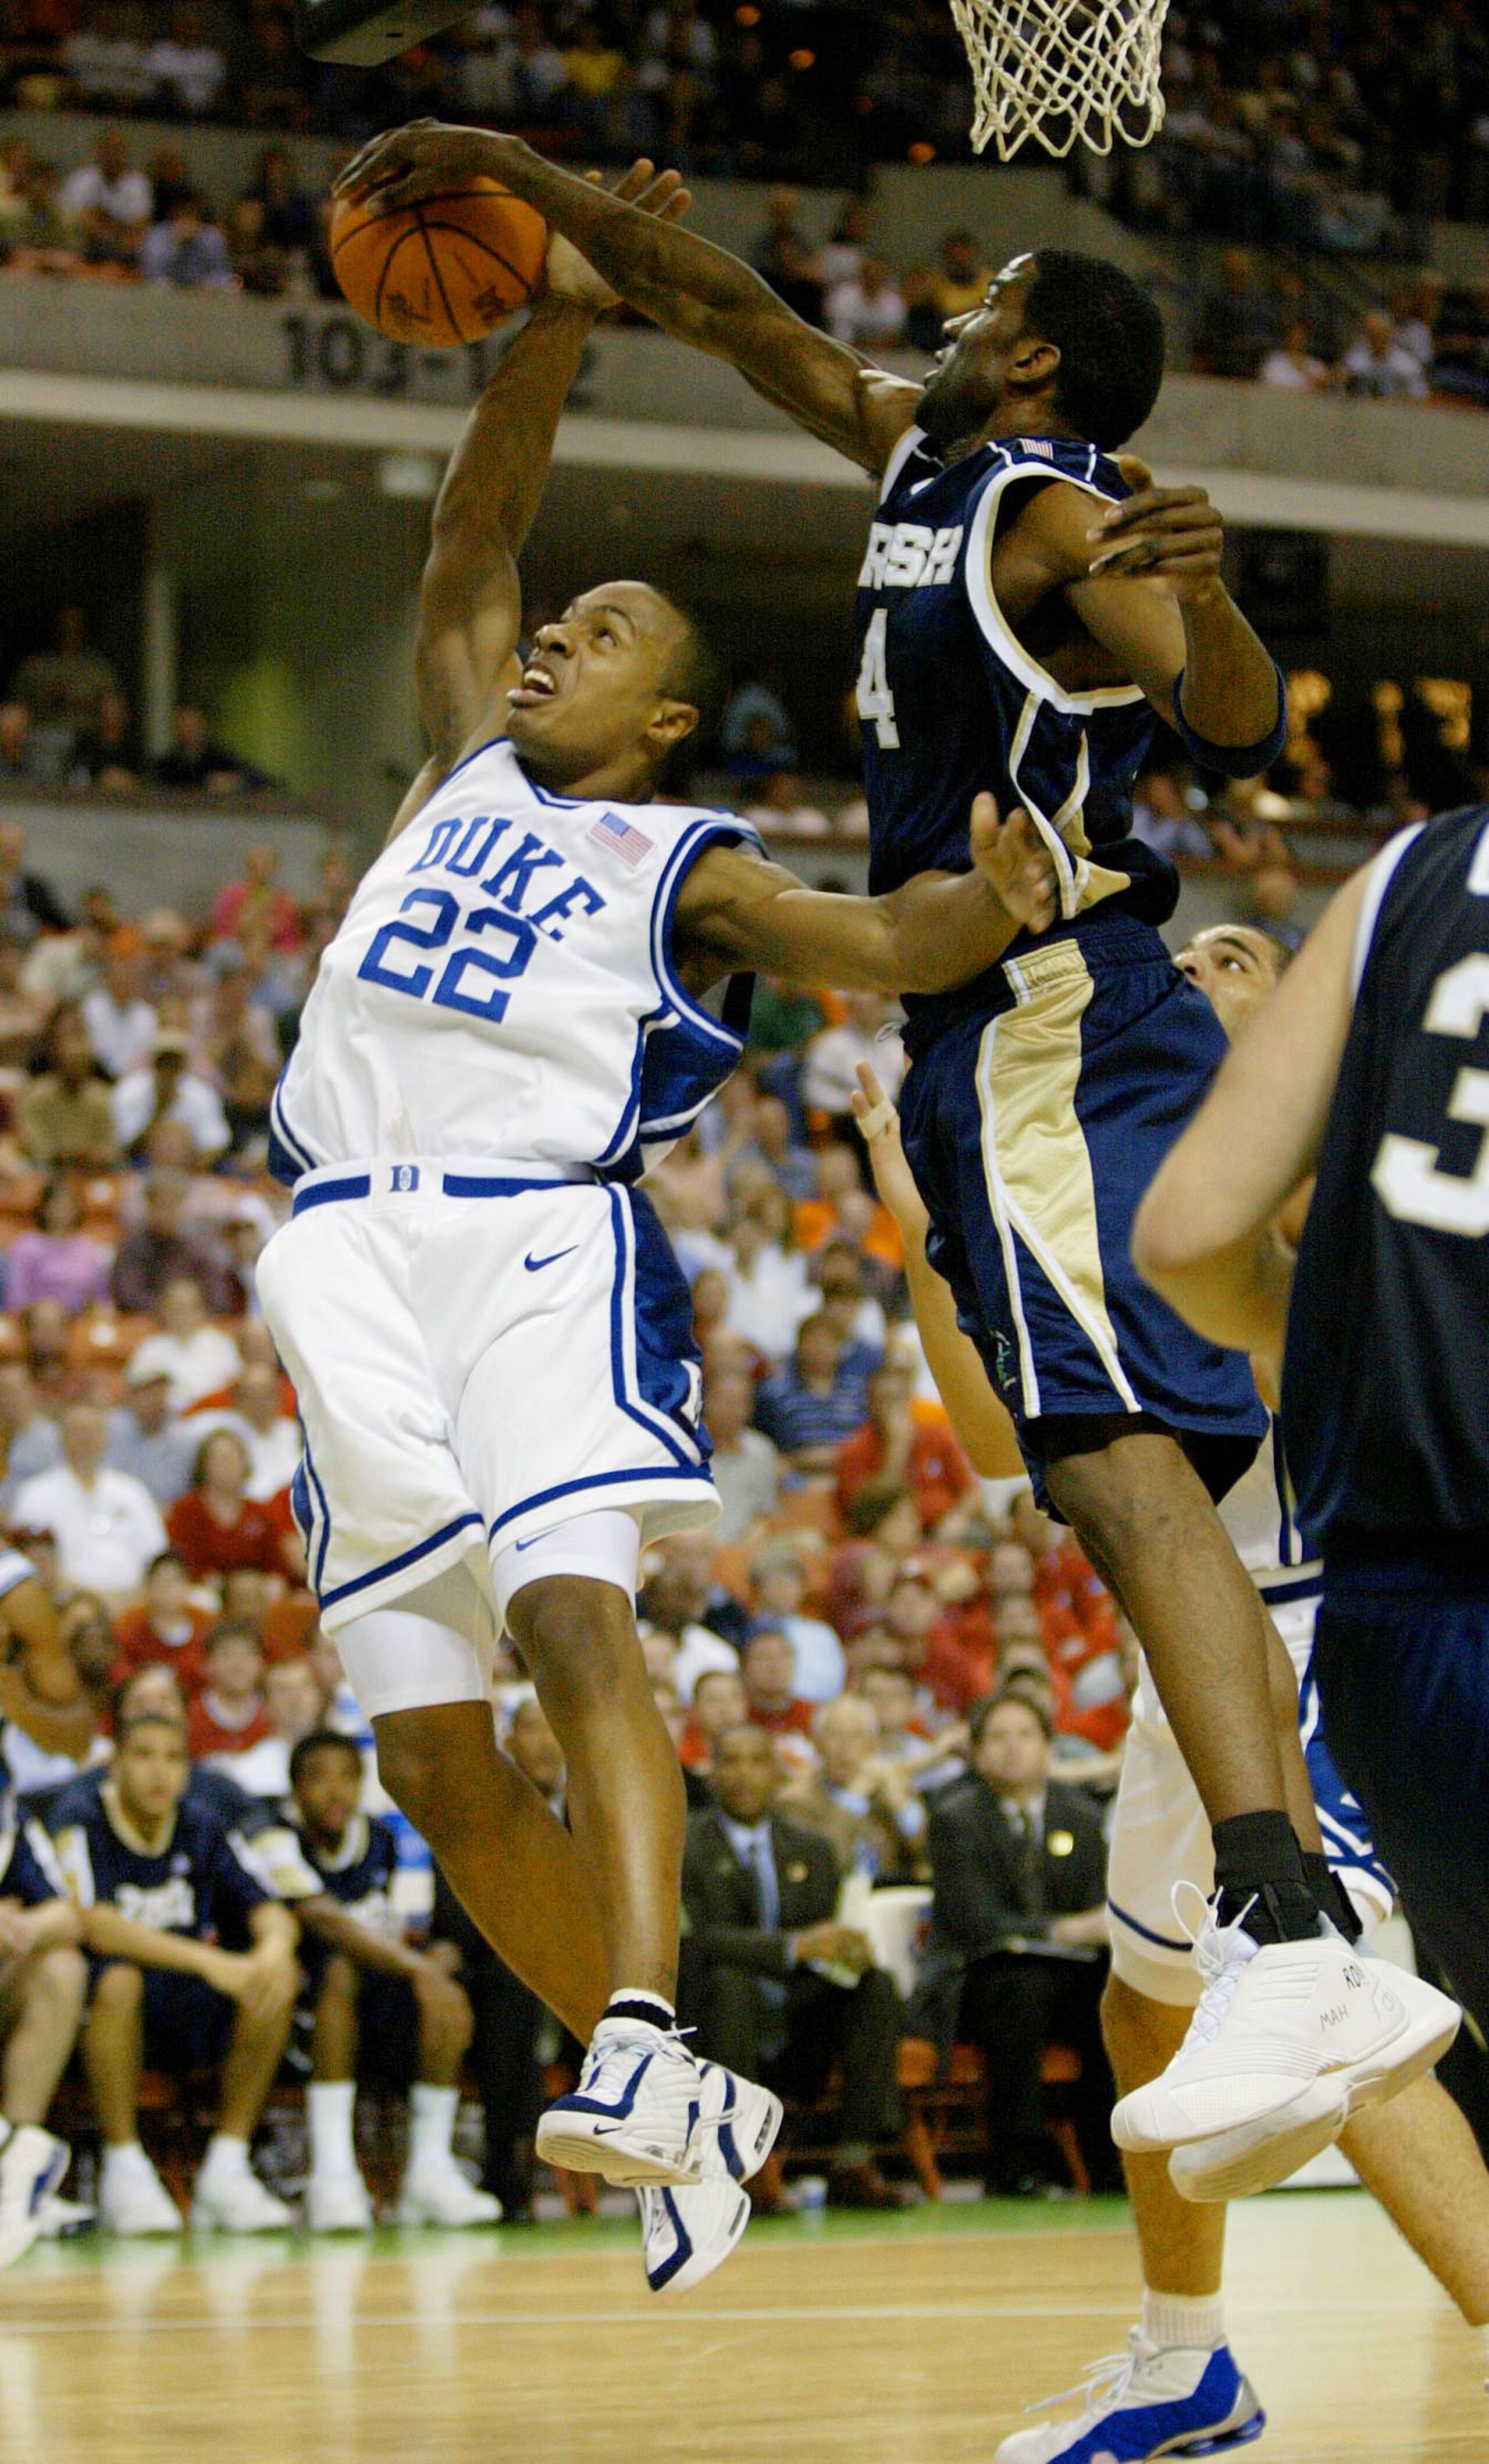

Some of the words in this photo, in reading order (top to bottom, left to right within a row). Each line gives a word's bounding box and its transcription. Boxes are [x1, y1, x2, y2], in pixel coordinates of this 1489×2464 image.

[856, 608, 900, 749] 4
[408, 817, 607, 942] DUKE
[357, 888, 538, 1024] 22
